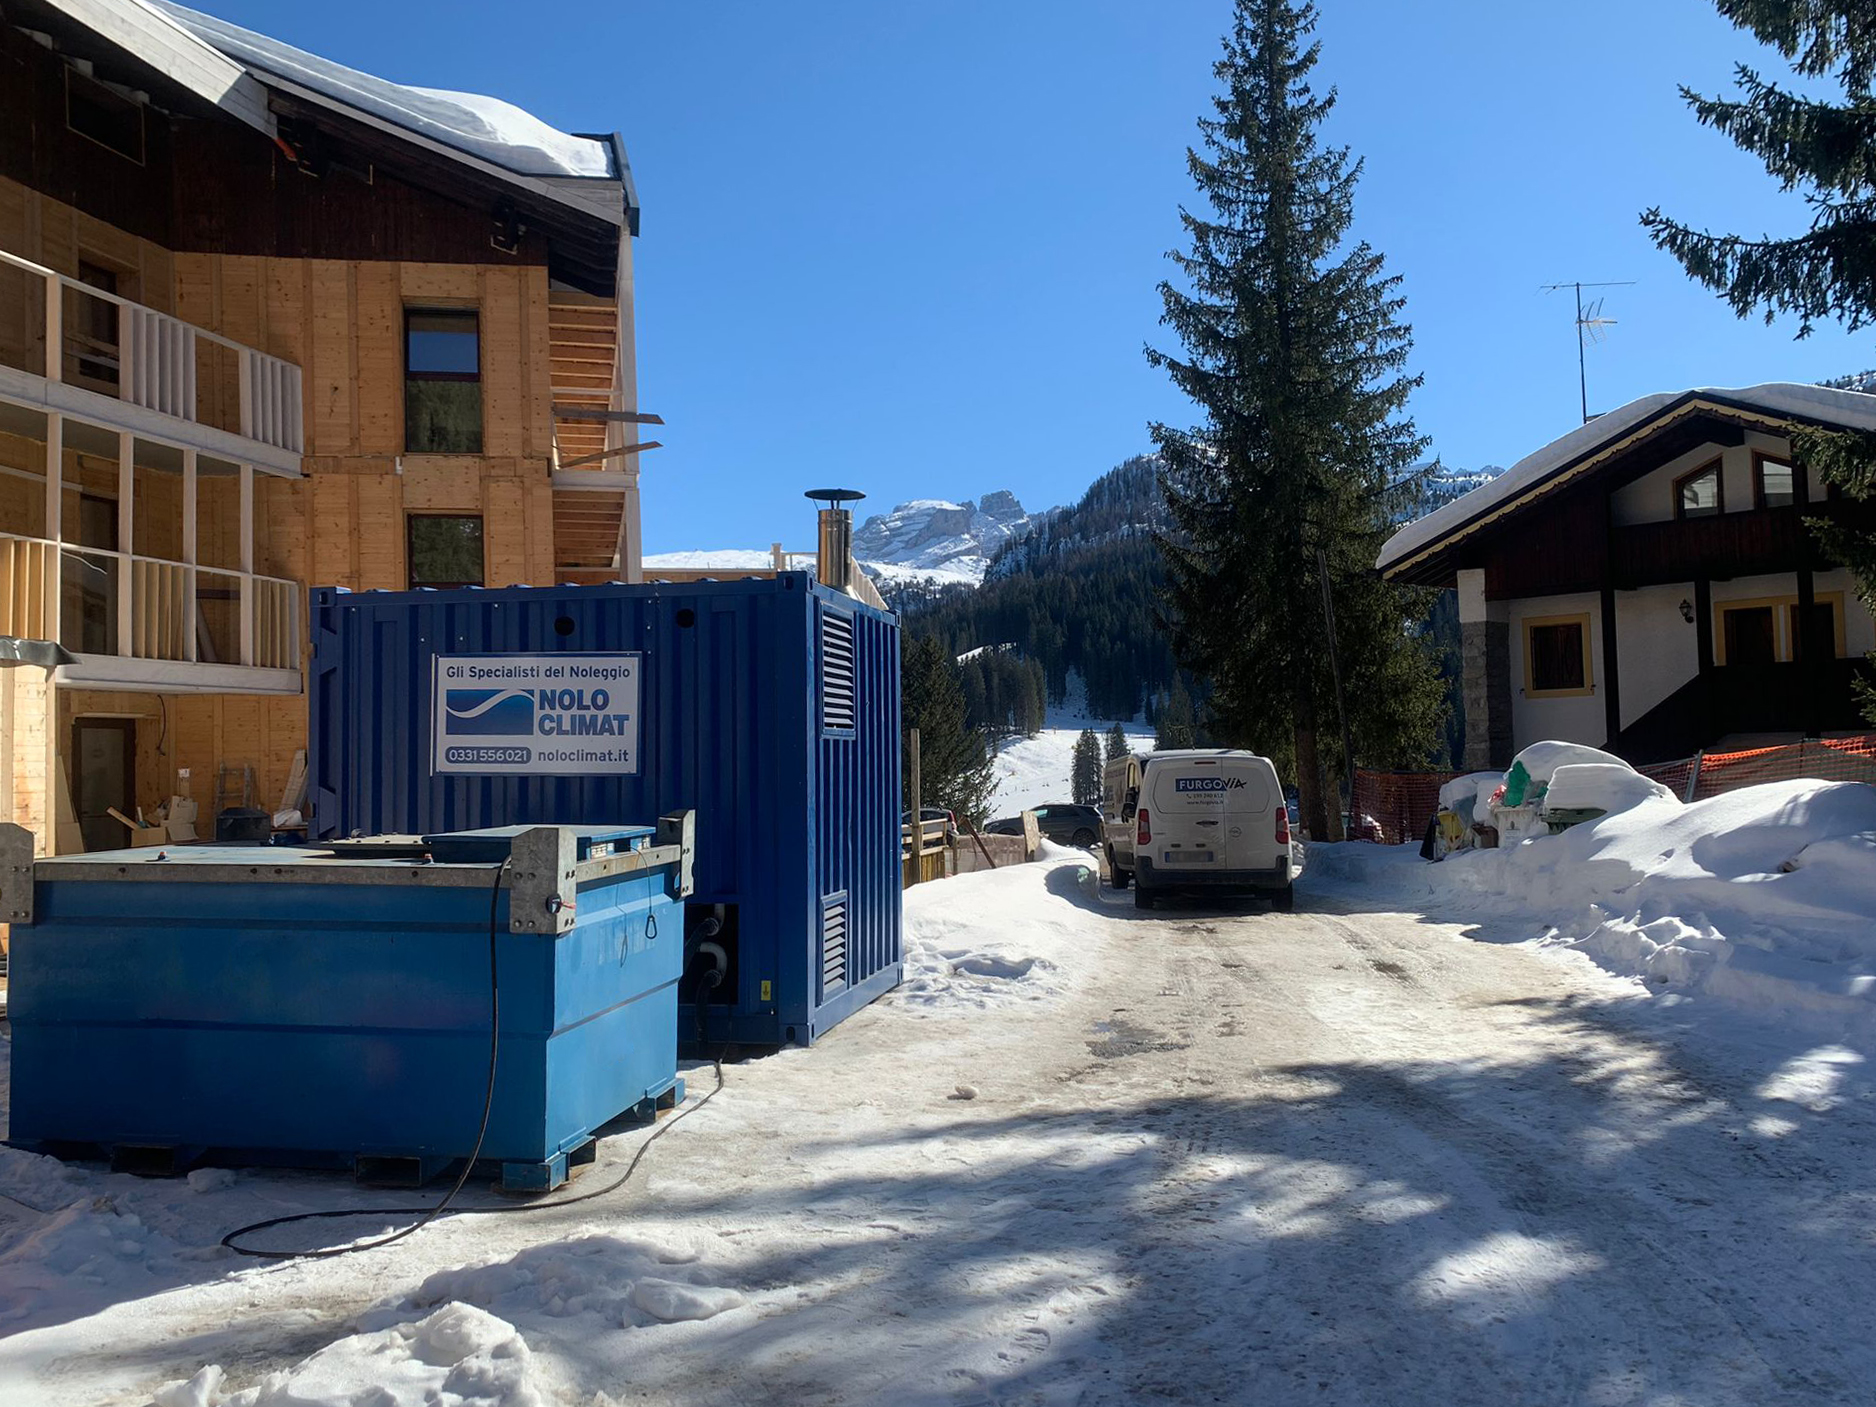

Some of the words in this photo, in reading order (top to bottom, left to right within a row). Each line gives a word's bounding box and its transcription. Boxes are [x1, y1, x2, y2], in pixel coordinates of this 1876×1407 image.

[446, 666, 464, 678] Gli
[469, 666, 540, 680] Specialisti
[544, 666, 565, 678] del
[570, 666, 630, 680] Noleggio
[539, 689, 610, 711] NOLO
[538, 714, 630, 736] CLIMAT
[538, 749, 629, 762] noloclimat.it
